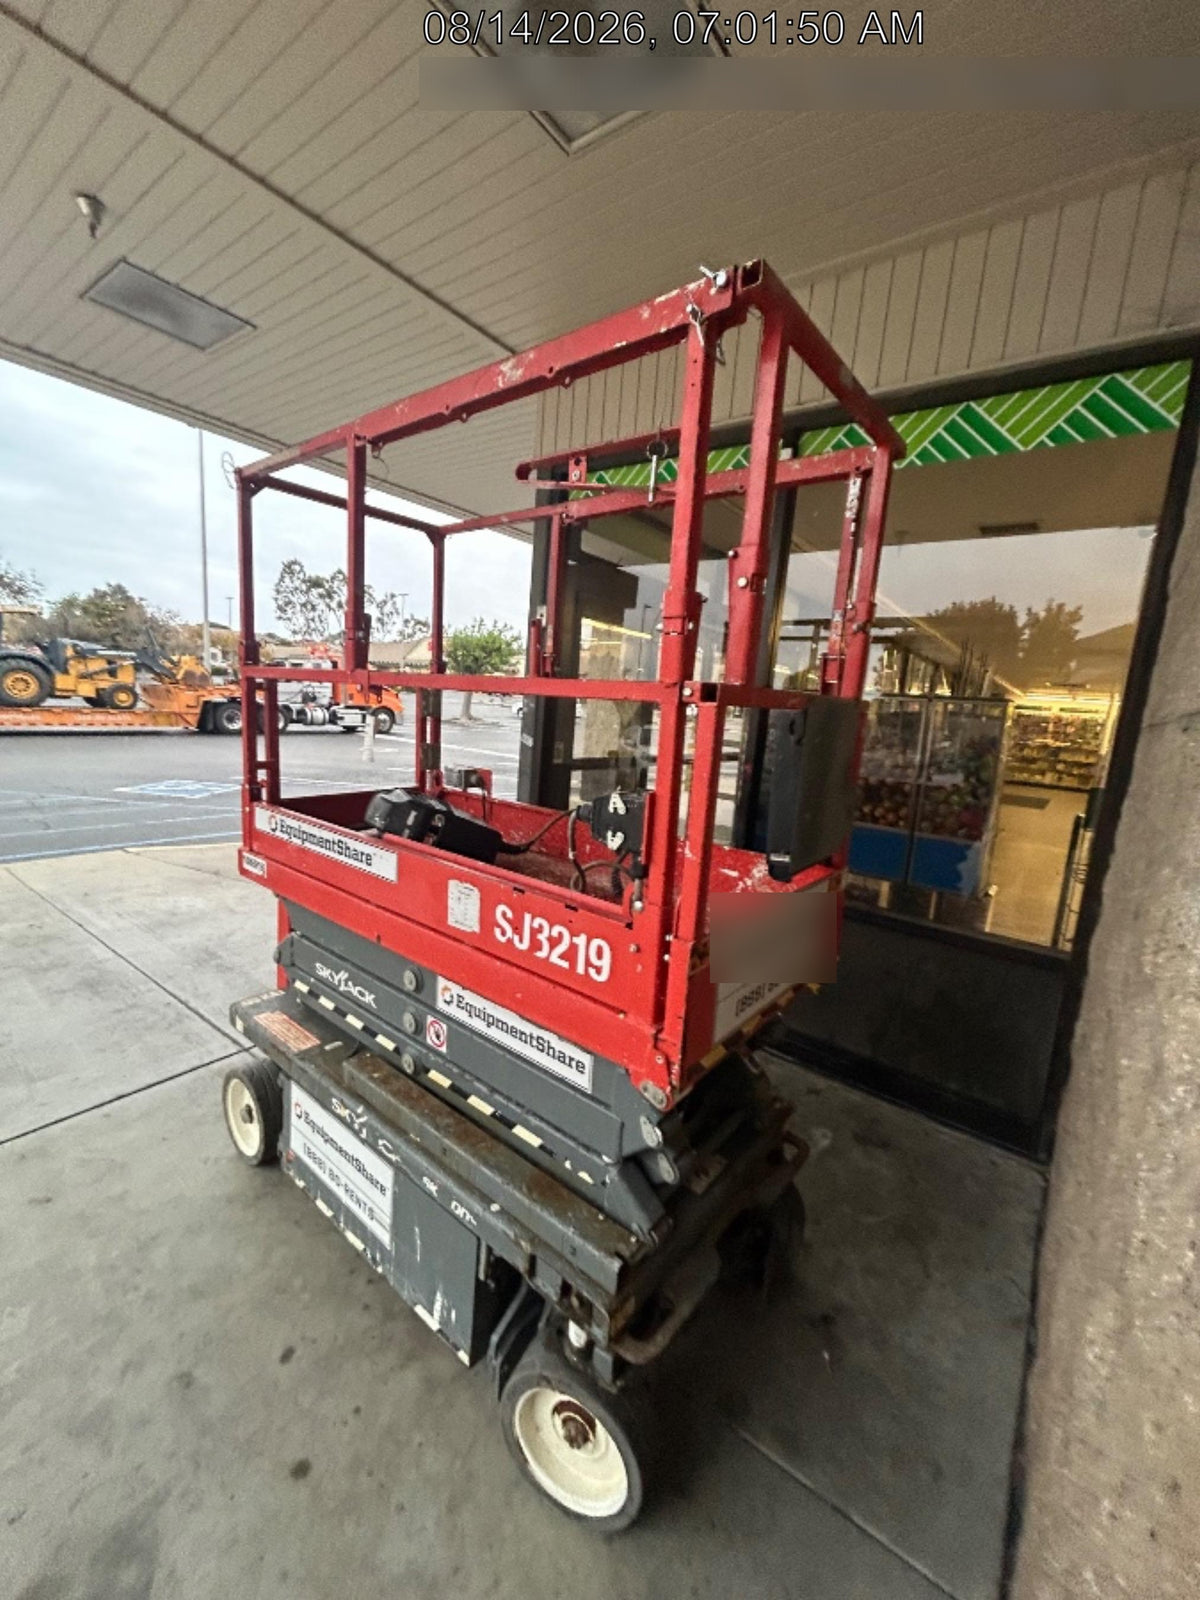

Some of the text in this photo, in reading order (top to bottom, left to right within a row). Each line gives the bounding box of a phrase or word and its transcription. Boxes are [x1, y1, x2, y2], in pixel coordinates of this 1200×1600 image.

[278, 817, 373, 868] EquipmentShare
[493, 903, 612, 983] SJ3219
[314, 961, 379, 1009] SKYJACK
[455, 992, 587, 1076] EquipmentShare
[303, 1109, 388, 1197] EquipmentShare
